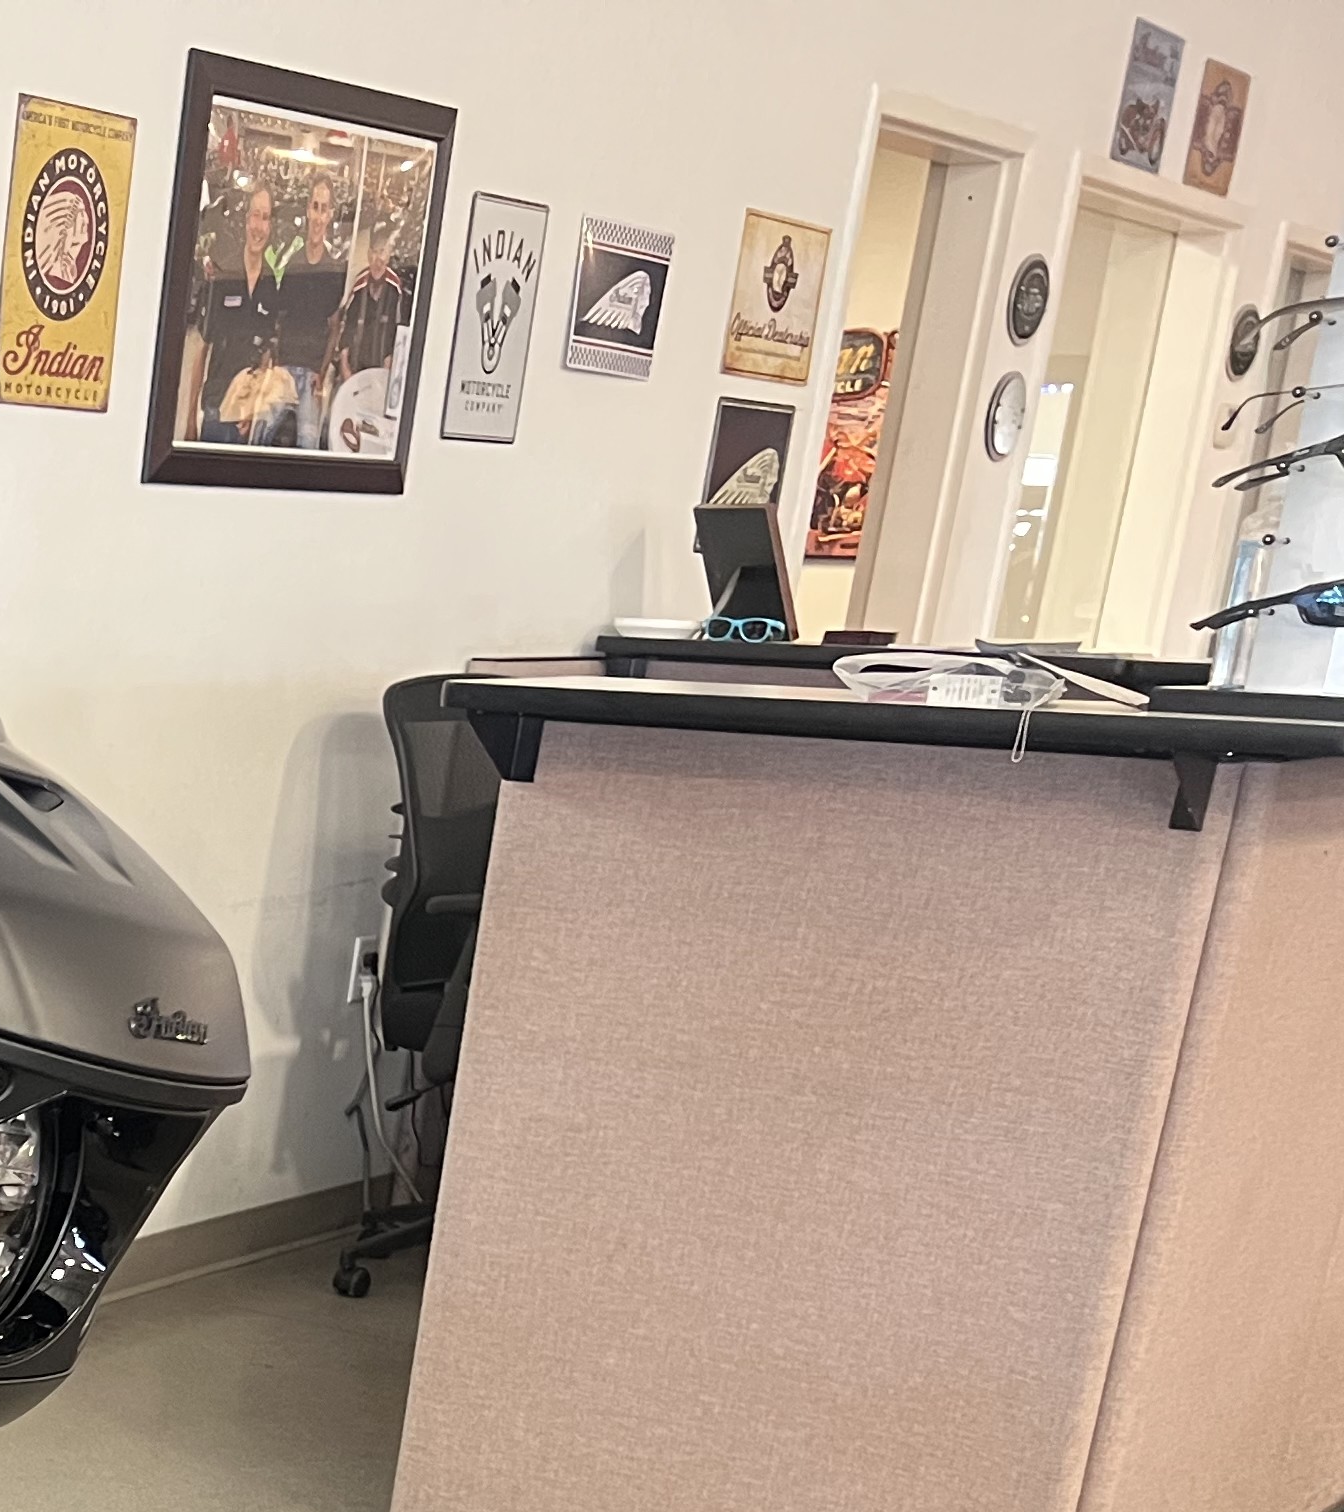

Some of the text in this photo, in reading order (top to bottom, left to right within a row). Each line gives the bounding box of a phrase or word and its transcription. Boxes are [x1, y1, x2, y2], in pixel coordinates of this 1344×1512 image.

[24, 154, 106, 290] INDIAN MOTORCYCLE
[473, 230, 537, 283] INDIAN
[43, 294, 75, 316] 1901
[2, 324, 105, 382] Indian
[4, 382, 98, 402] MOTORCYCLE
[128, 997, 208, 1046] Indian
